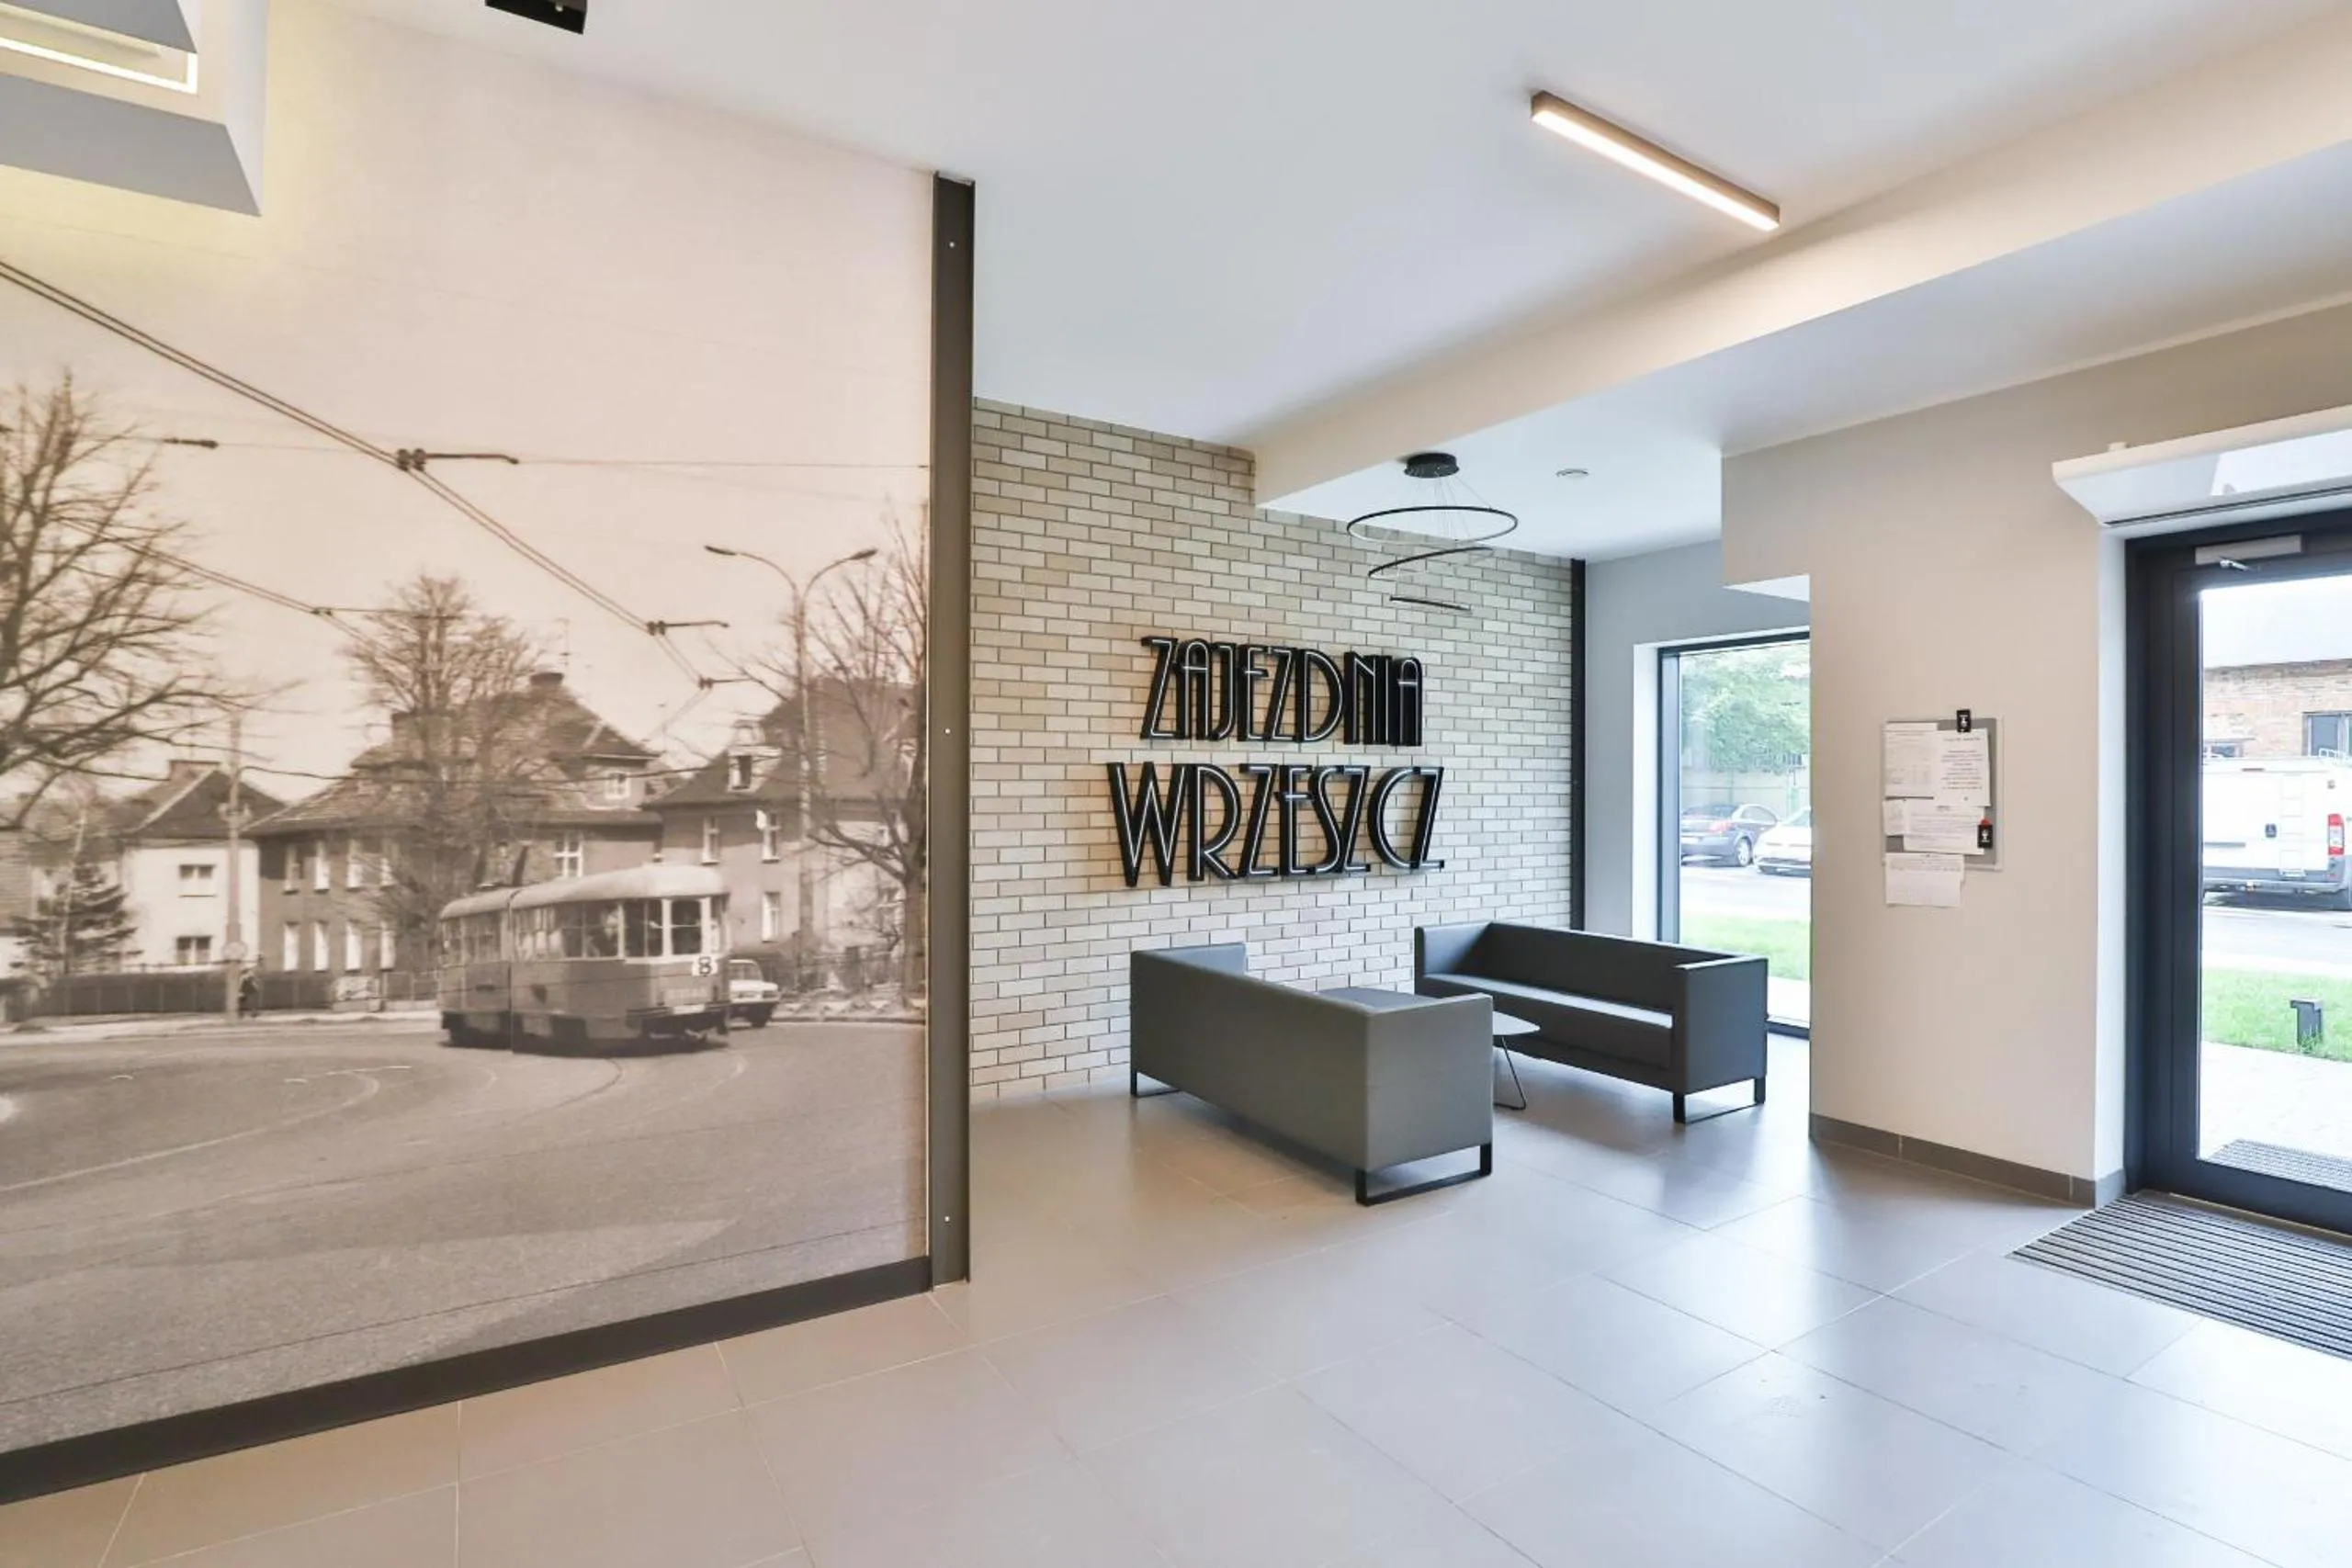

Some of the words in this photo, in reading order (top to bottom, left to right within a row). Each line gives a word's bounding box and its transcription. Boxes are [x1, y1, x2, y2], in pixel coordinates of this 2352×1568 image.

[1140, 636, 1423, 747] ZAJEZDNIA
[1107, 761, 1445, 887] WRZESZCZ
[698, 956, 712, 976] 8
